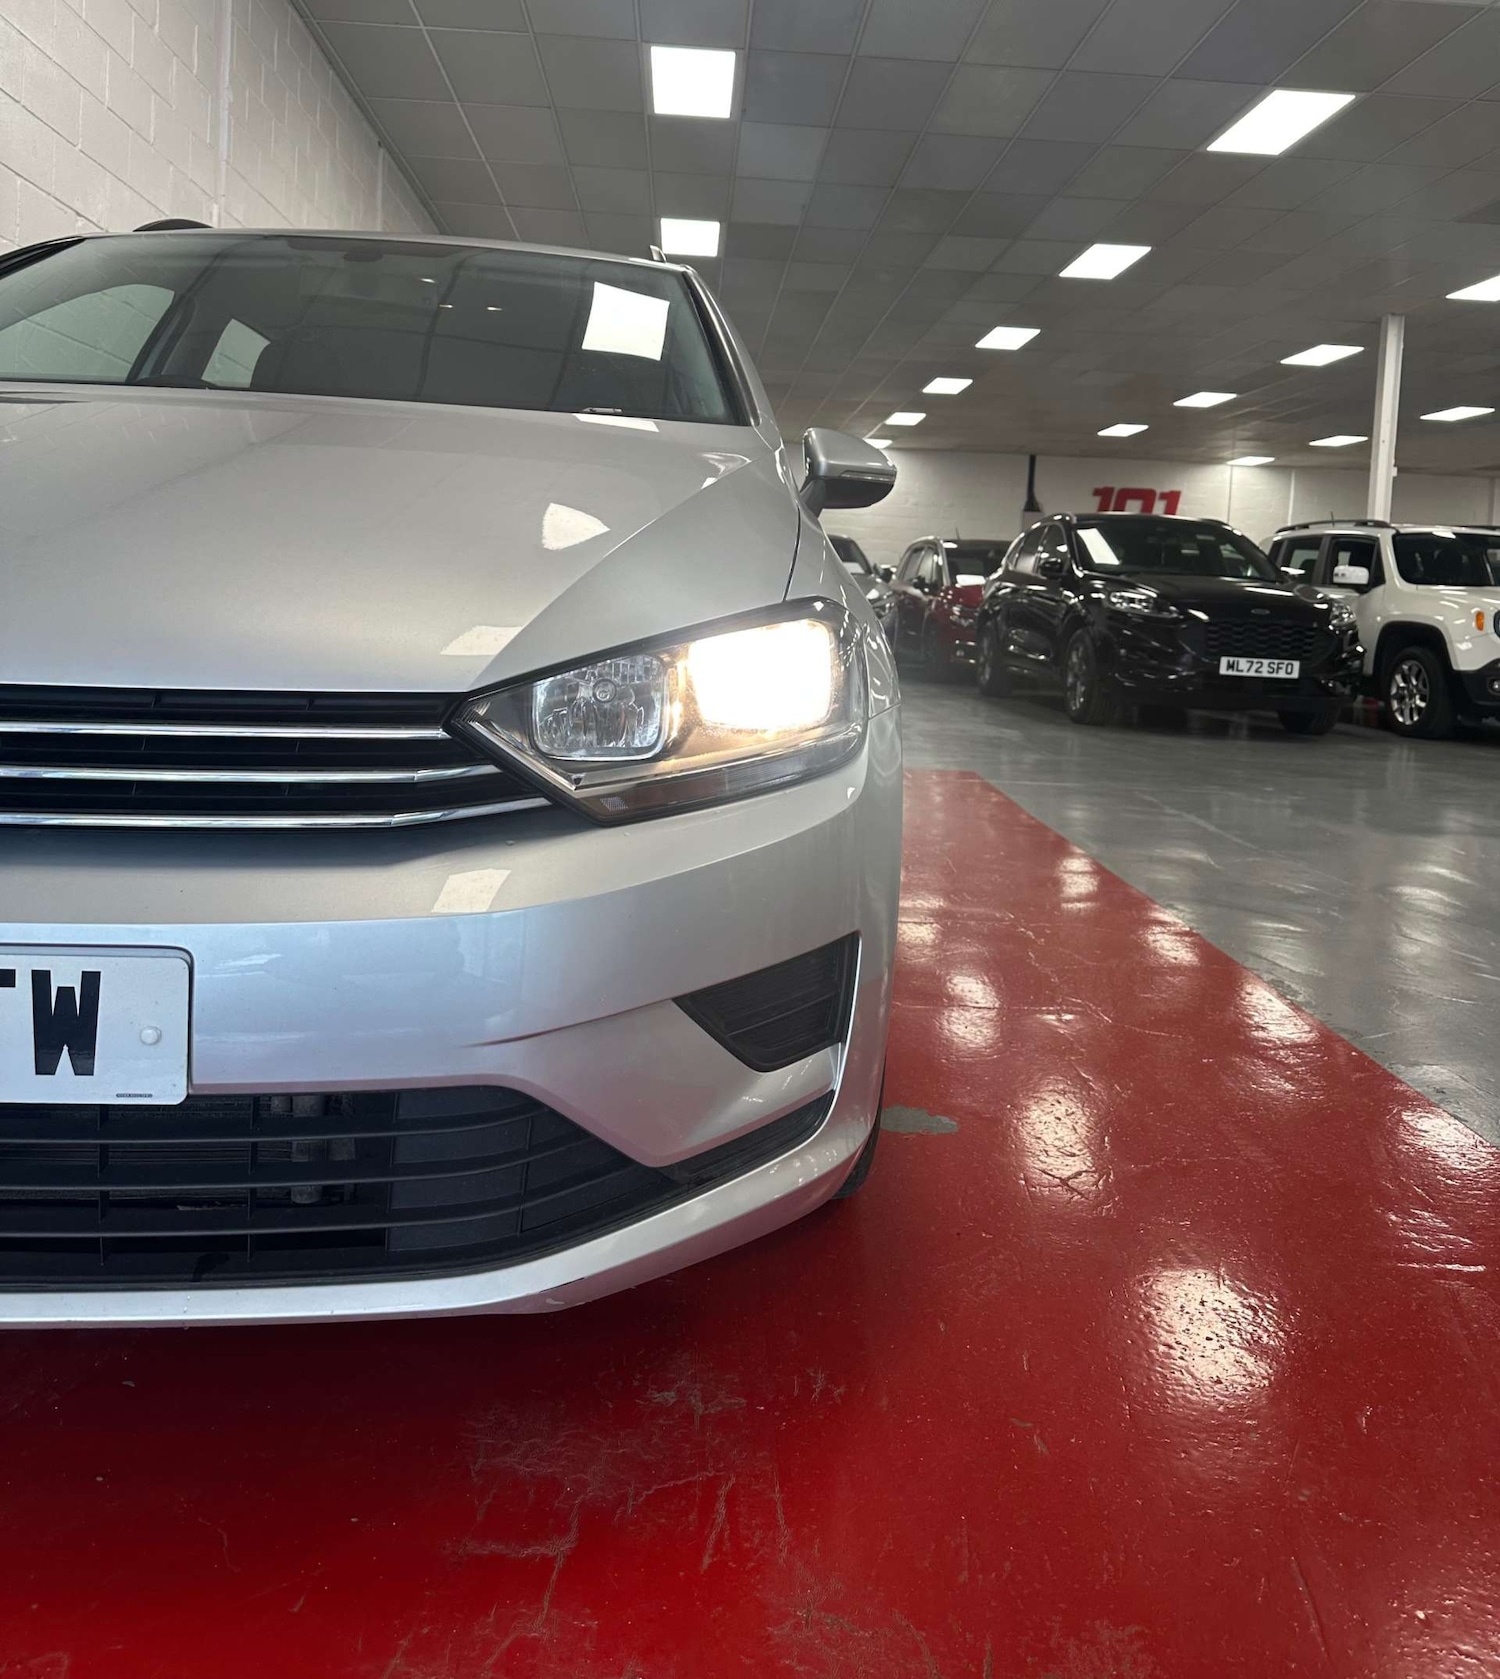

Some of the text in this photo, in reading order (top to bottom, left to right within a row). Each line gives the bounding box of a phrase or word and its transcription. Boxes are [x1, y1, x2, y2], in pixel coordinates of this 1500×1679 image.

[1092, 486, 1181, 516] 101
[1226, 659, 1294, 675] ML72 SFO
[0, 969, 101, 1076] W
